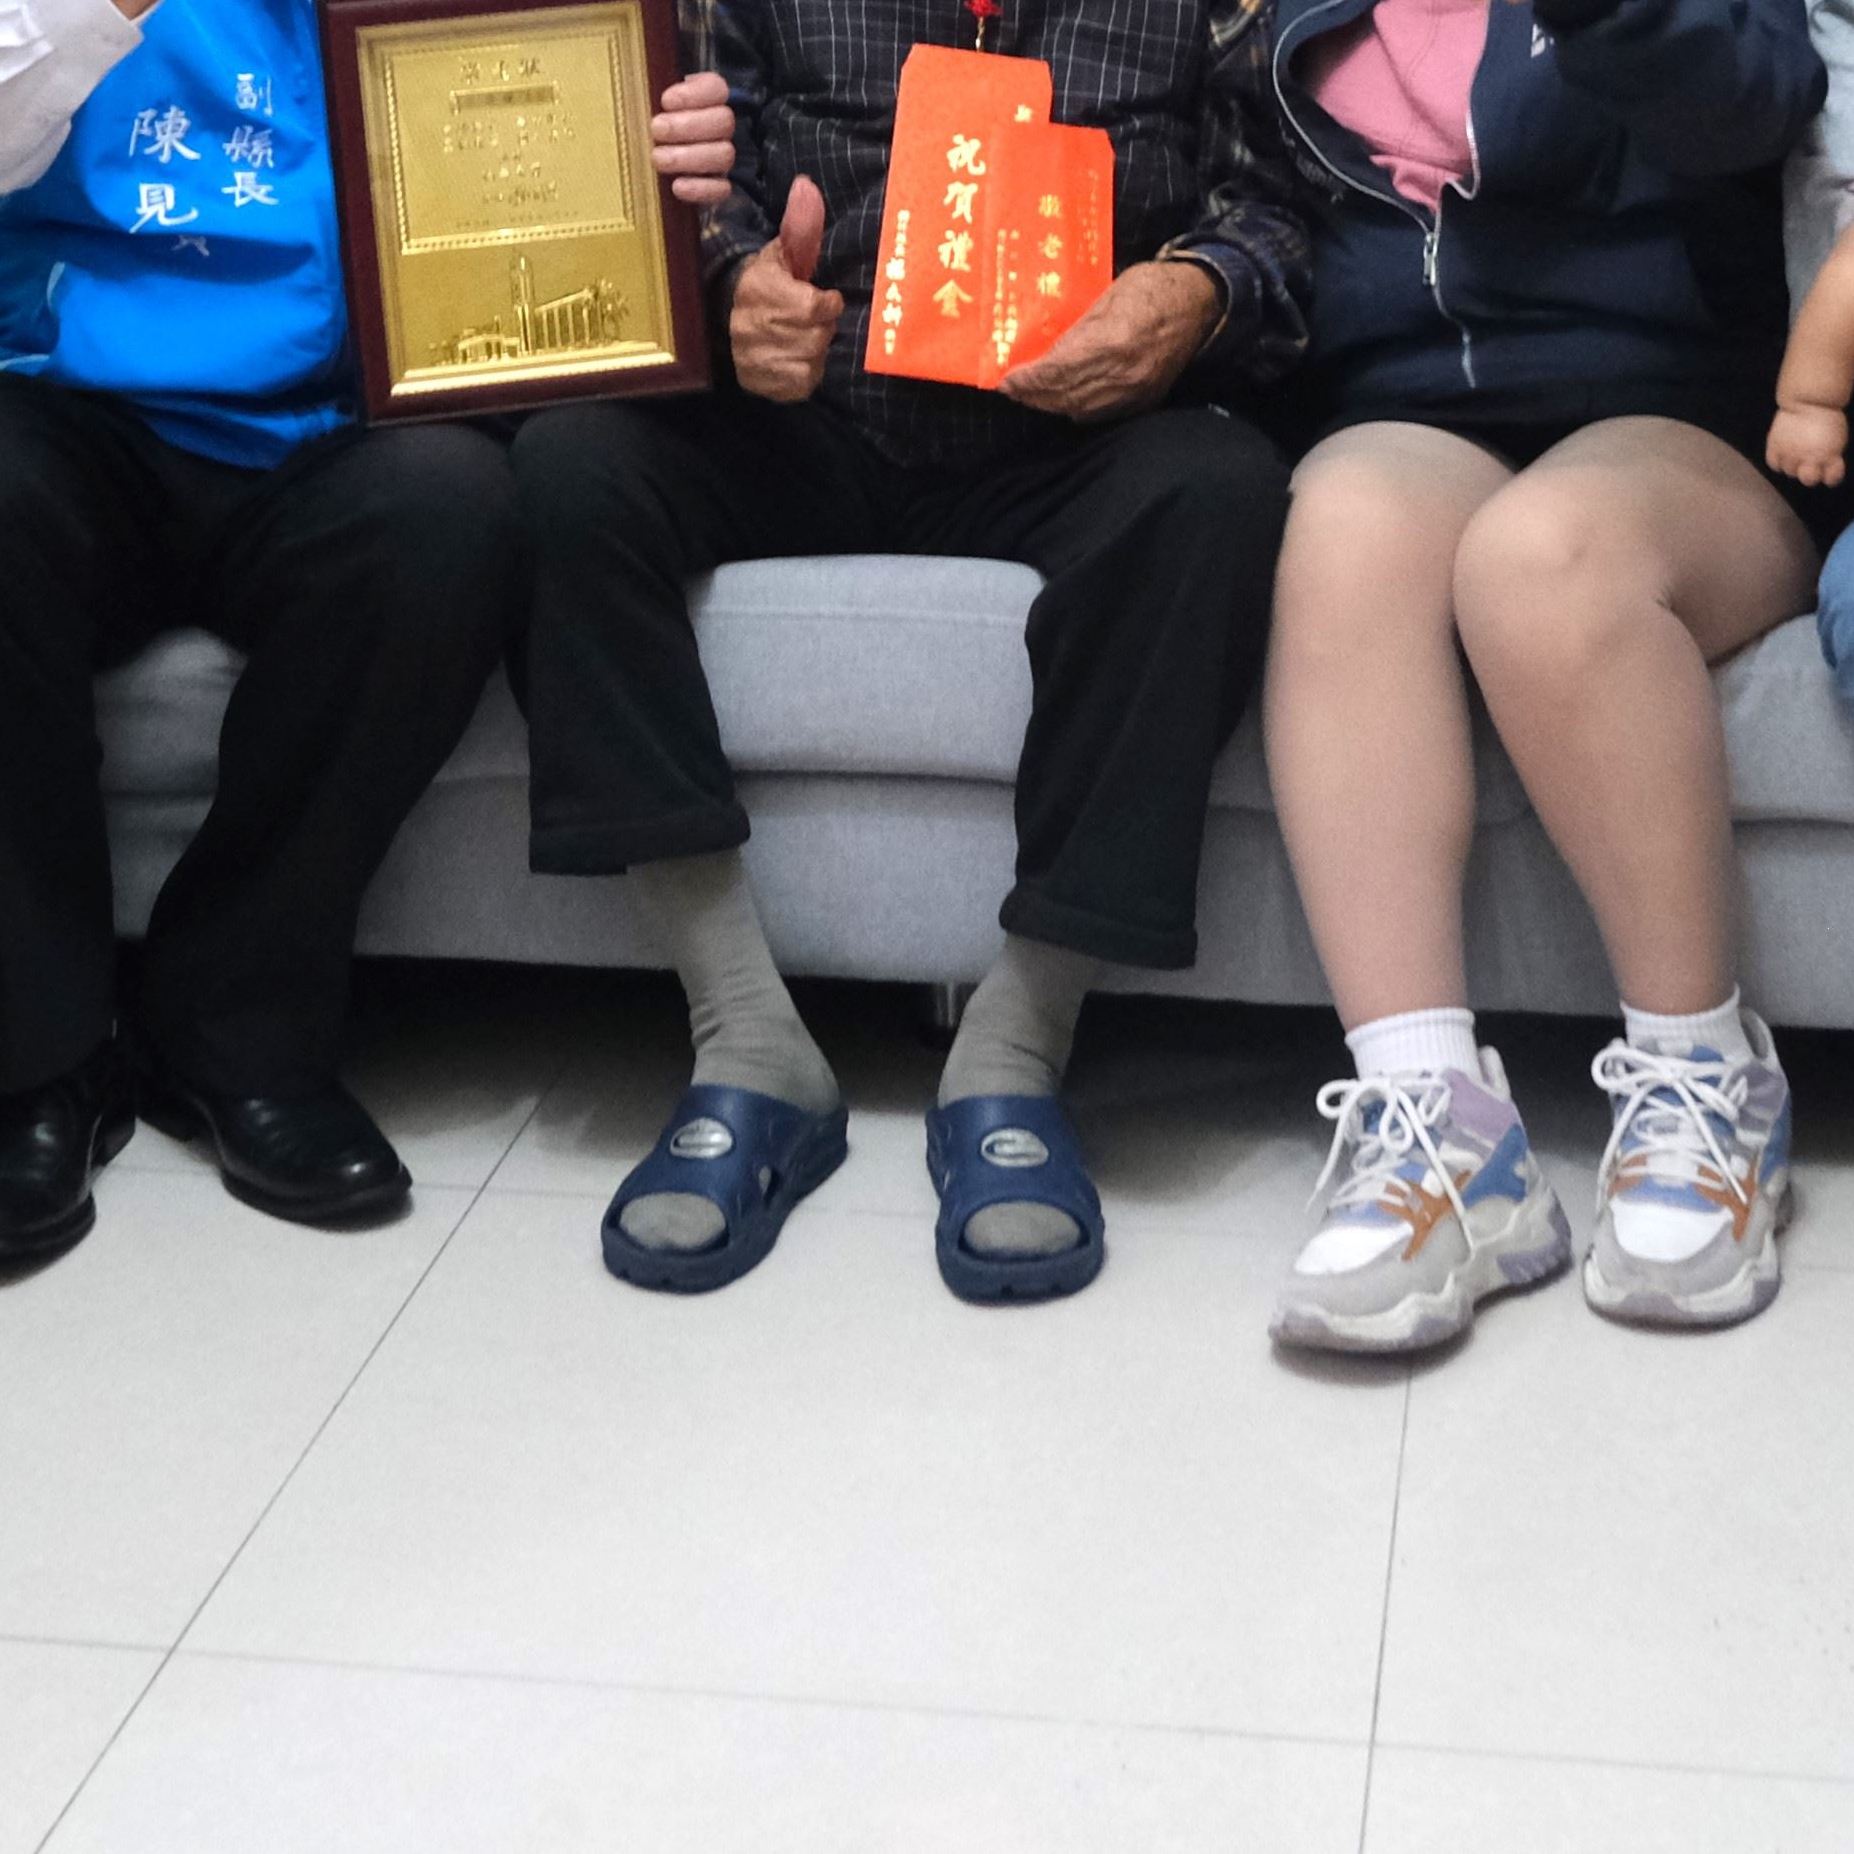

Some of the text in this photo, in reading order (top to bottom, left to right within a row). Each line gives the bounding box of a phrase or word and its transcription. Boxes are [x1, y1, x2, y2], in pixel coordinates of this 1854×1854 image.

[129, 103, 210, 258] 陳見
[222, 72, 279, 208] 副縣長
[932, 133, 987, 320] 祝賀禮金
